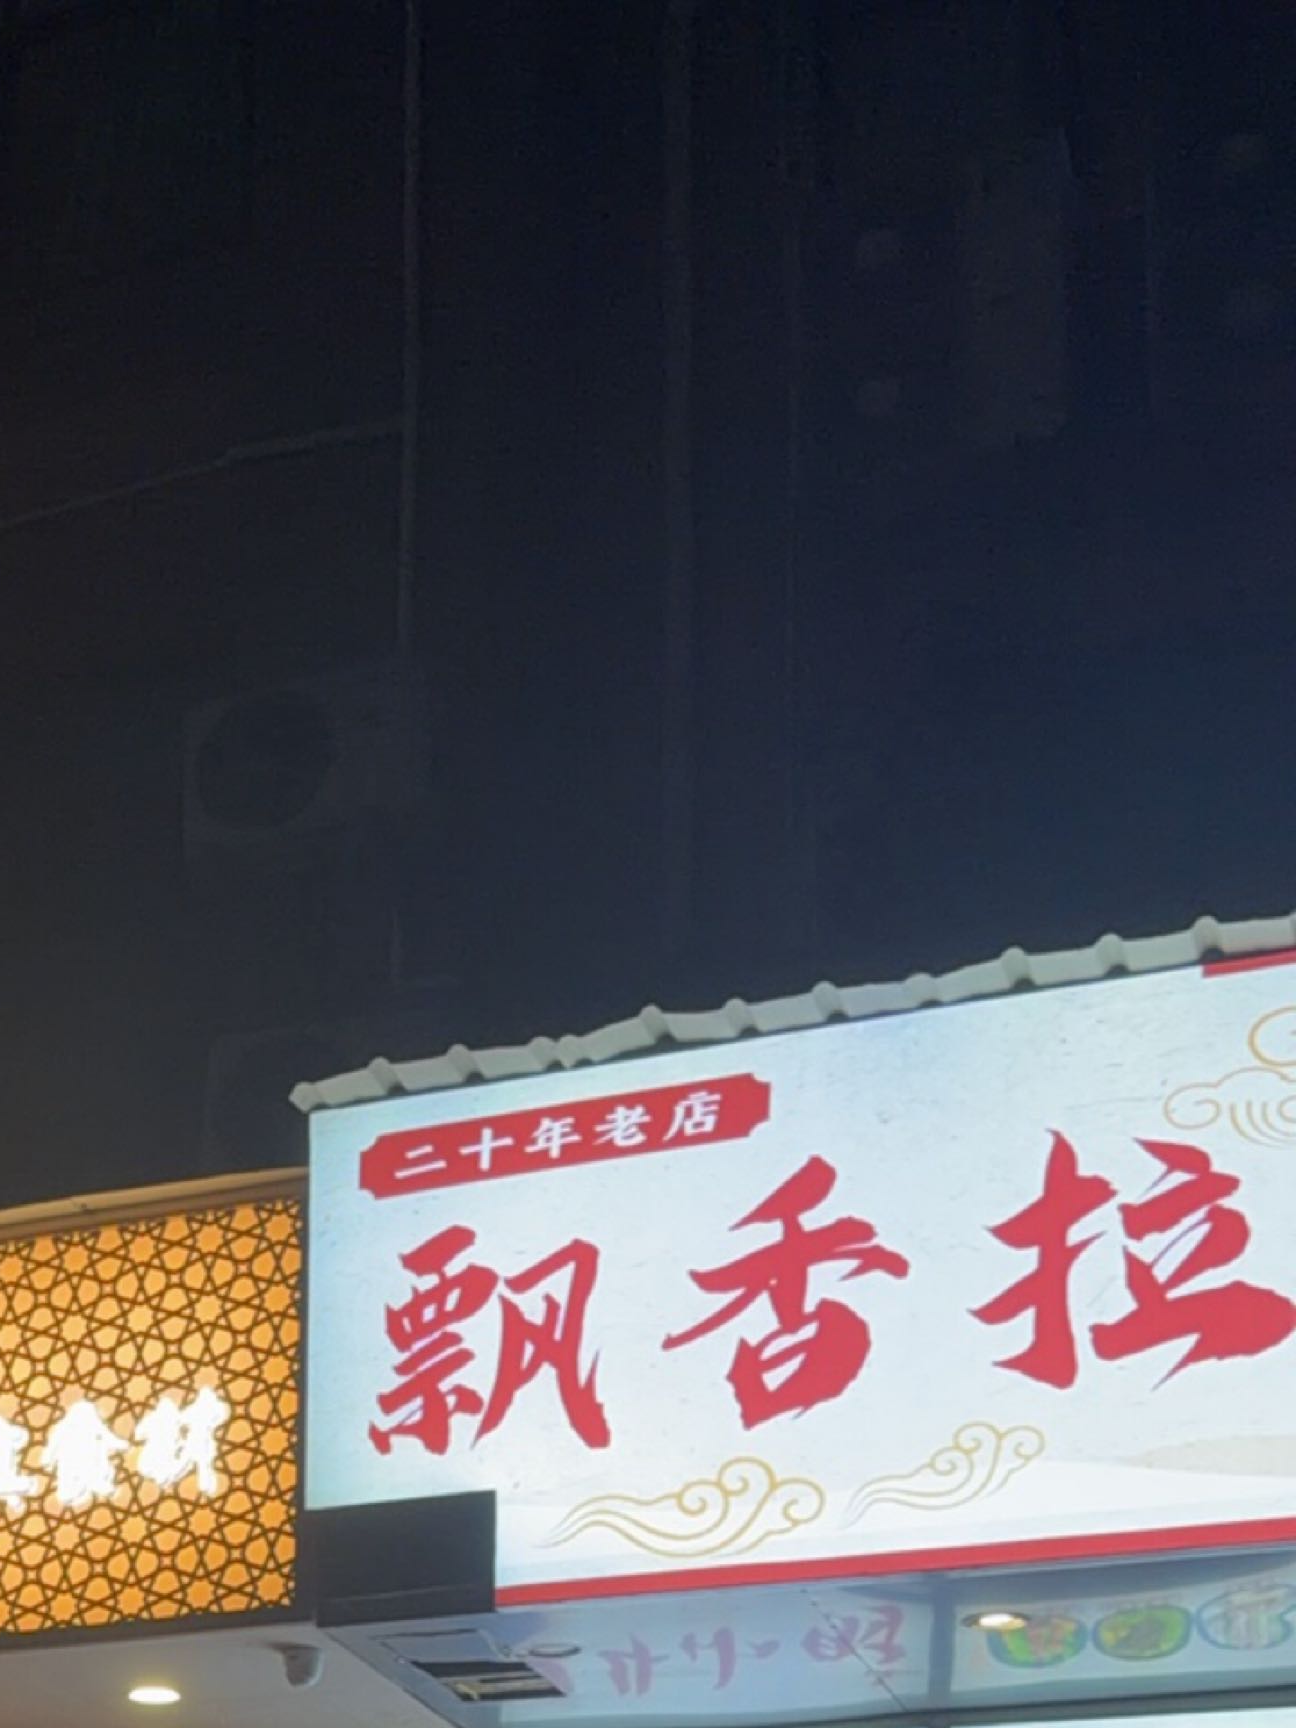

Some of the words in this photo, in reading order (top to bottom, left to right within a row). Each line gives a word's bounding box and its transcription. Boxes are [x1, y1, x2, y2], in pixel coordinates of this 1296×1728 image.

[394, 1090, 722, 1180] 二十年老店
[368, 1128, 1296, 1456] 飘香拉
